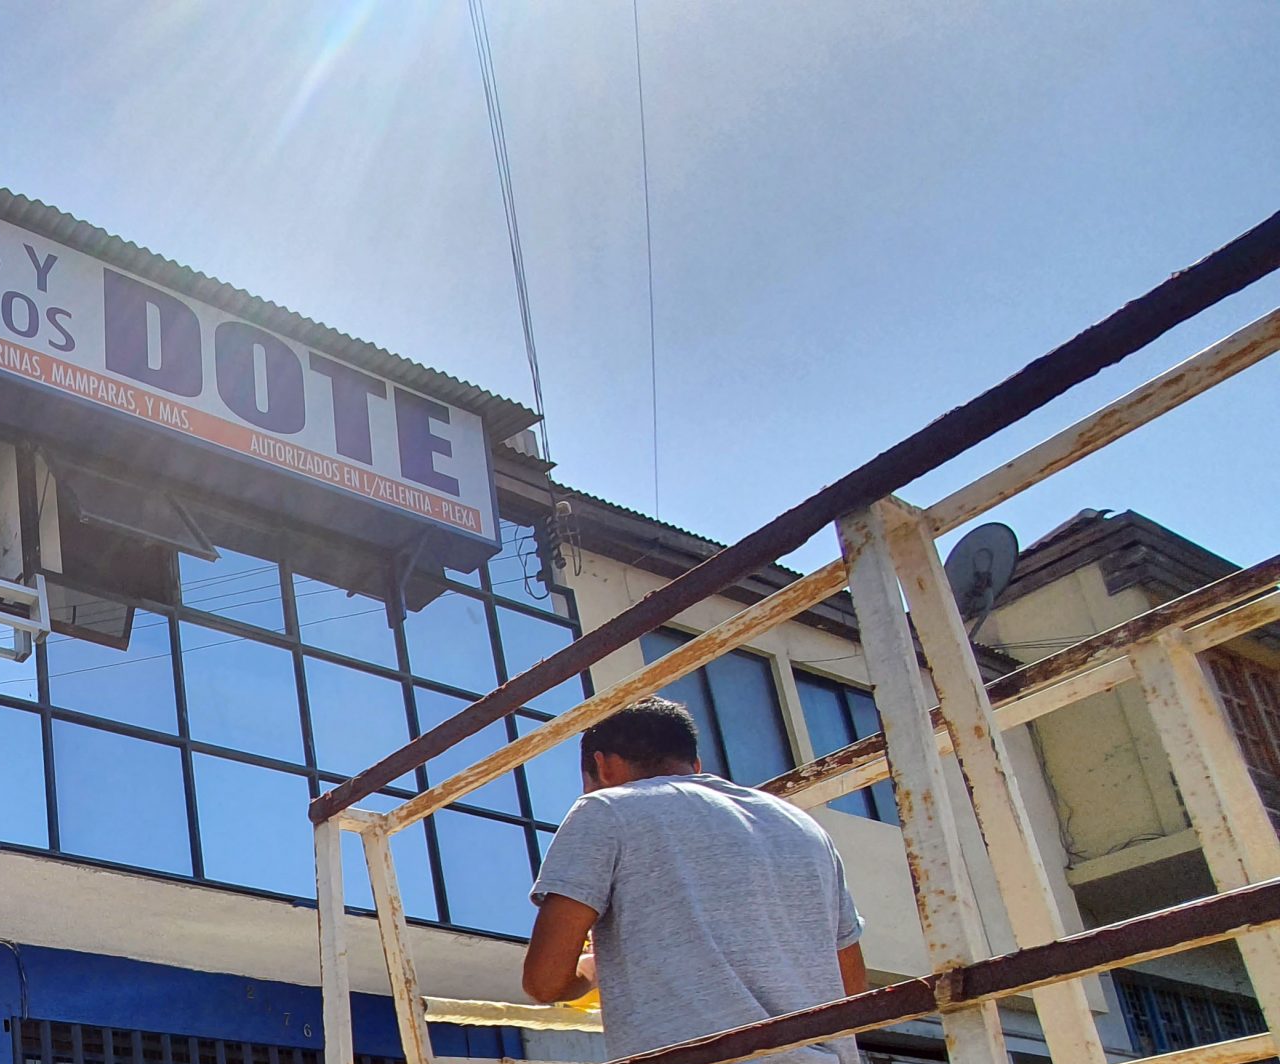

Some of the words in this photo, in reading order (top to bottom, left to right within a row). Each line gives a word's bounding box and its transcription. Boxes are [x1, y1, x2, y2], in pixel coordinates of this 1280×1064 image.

[23, 243, 58, 293] Y
[51, 363, 140, 415] MAMPARAS,
[144, 396, 155, 417] Y
[159, 402, 193, 431] MAS.
[103, 267, 461, 497] DOTE
[250, 434, 340, 481] AUTORIZADOS
[344, 467, 360, 488] EN
[441, 501, 476, 528] PLEXA
